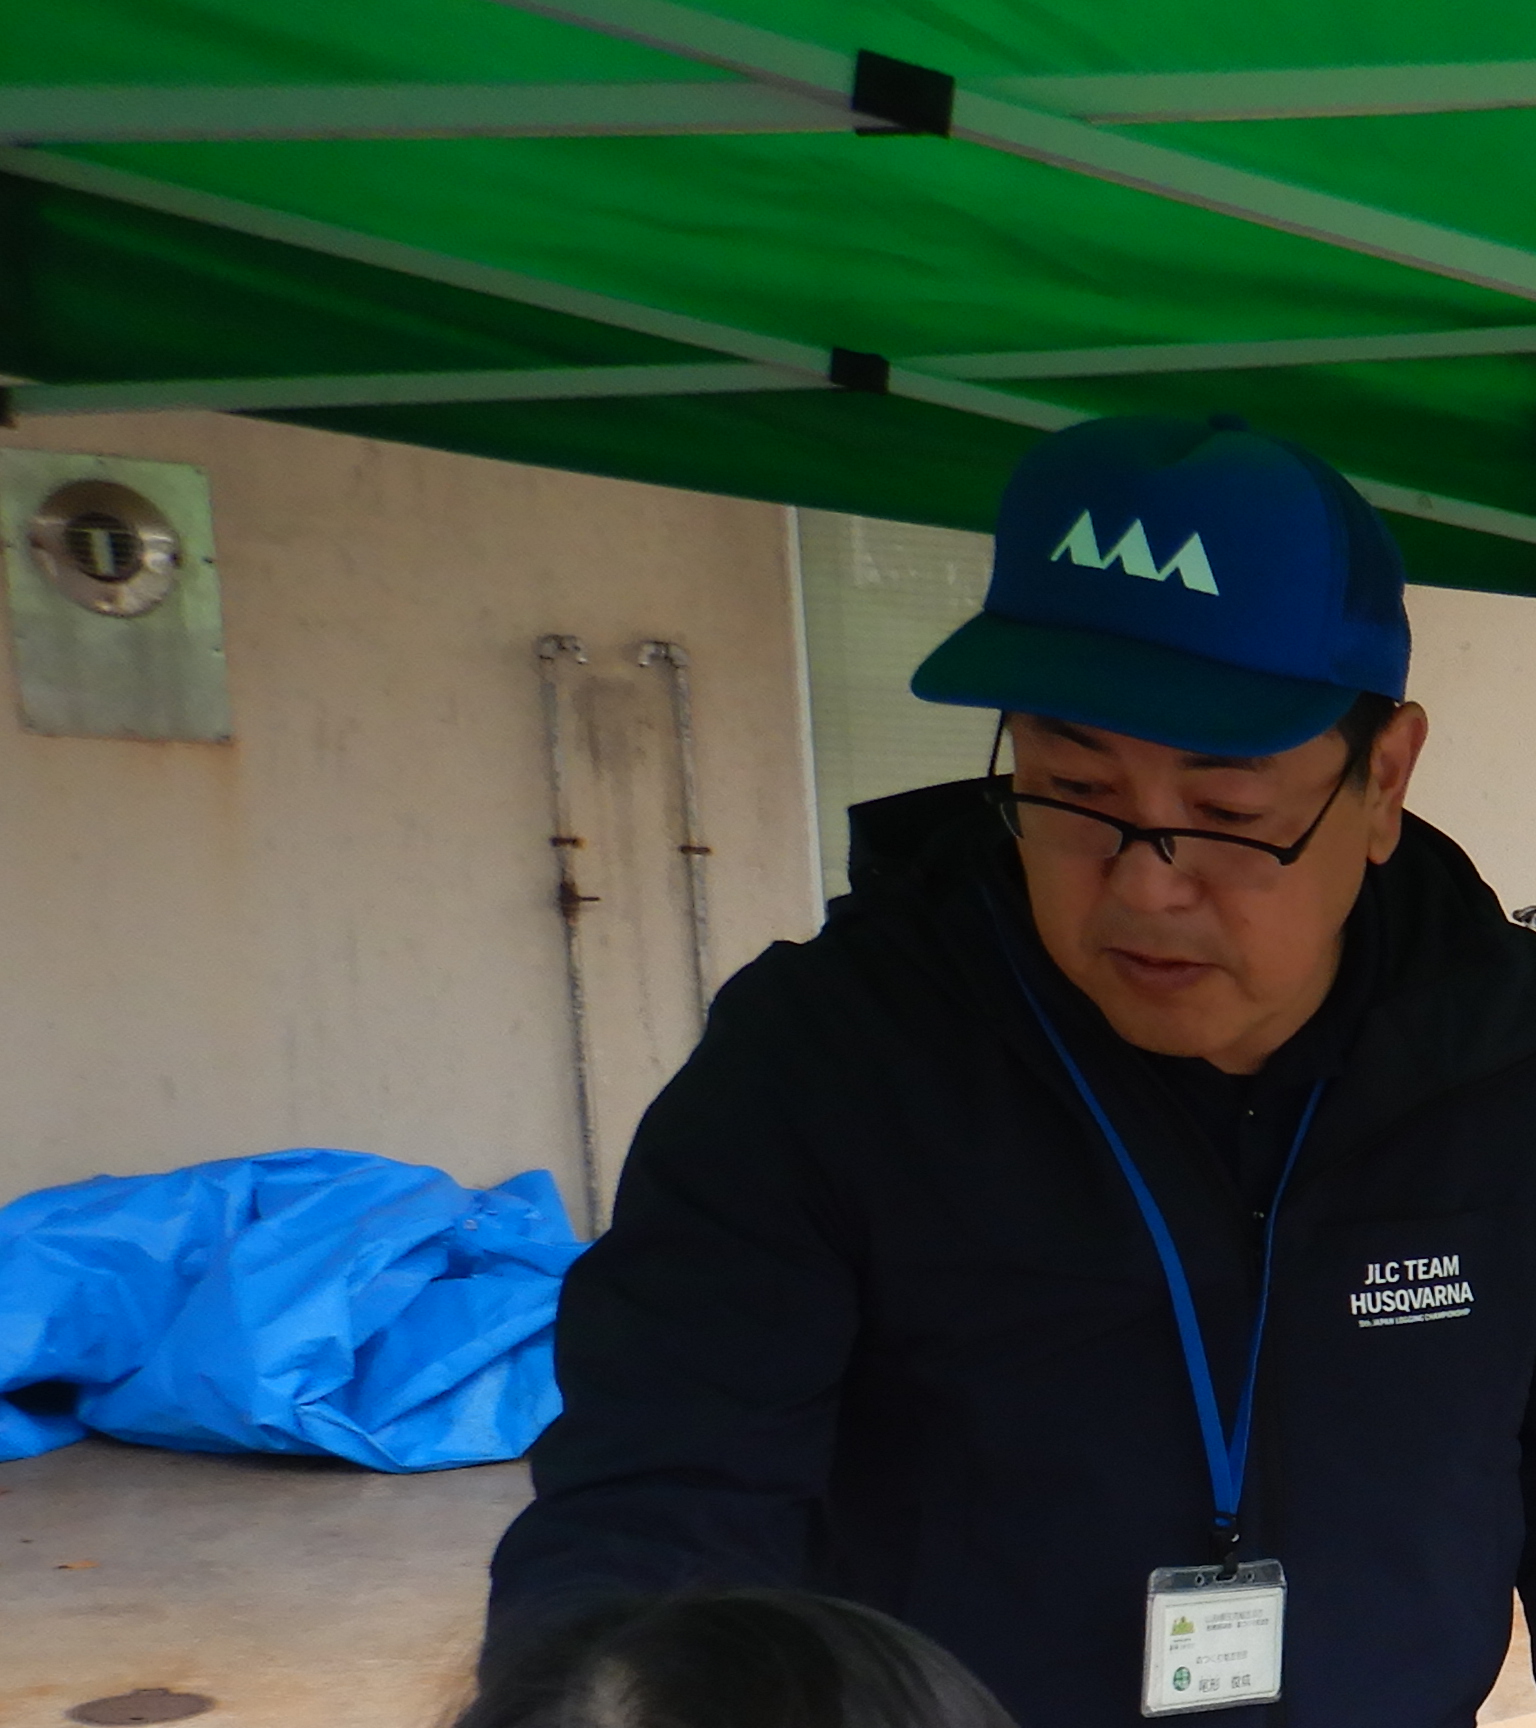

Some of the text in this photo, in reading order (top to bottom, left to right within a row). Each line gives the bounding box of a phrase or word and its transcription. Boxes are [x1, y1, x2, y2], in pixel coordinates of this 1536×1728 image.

[1364, 1254, 1460, 1286] JLC TEAM
[1350, 1281, 1475, 1316] HUSQVARNA
